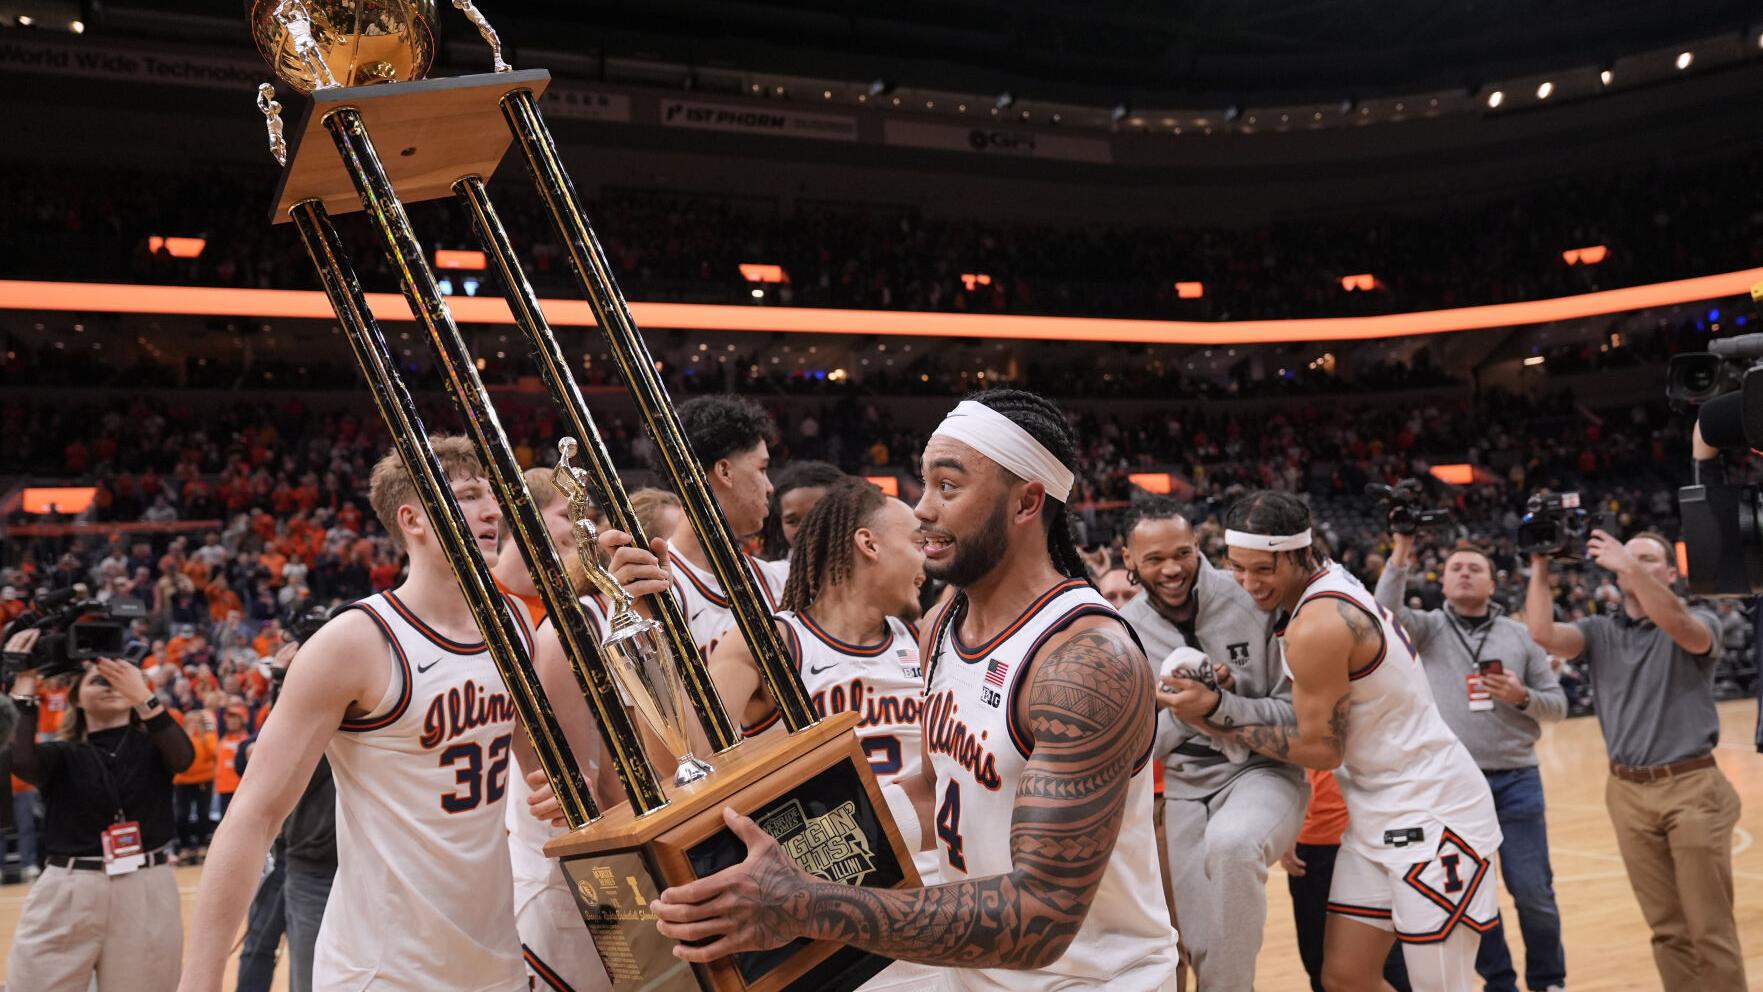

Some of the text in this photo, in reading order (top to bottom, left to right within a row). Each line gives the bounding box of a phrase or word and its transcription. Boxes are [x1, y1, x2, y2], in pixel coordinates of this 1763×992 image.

[75, 52, 138, 73] Wide
[142, 56, 268, 84] Technolog
[439, 733, 513, 814] 32
[937, 778, 968, 875] 4
[831, 857, 863, 881] ILLINI
